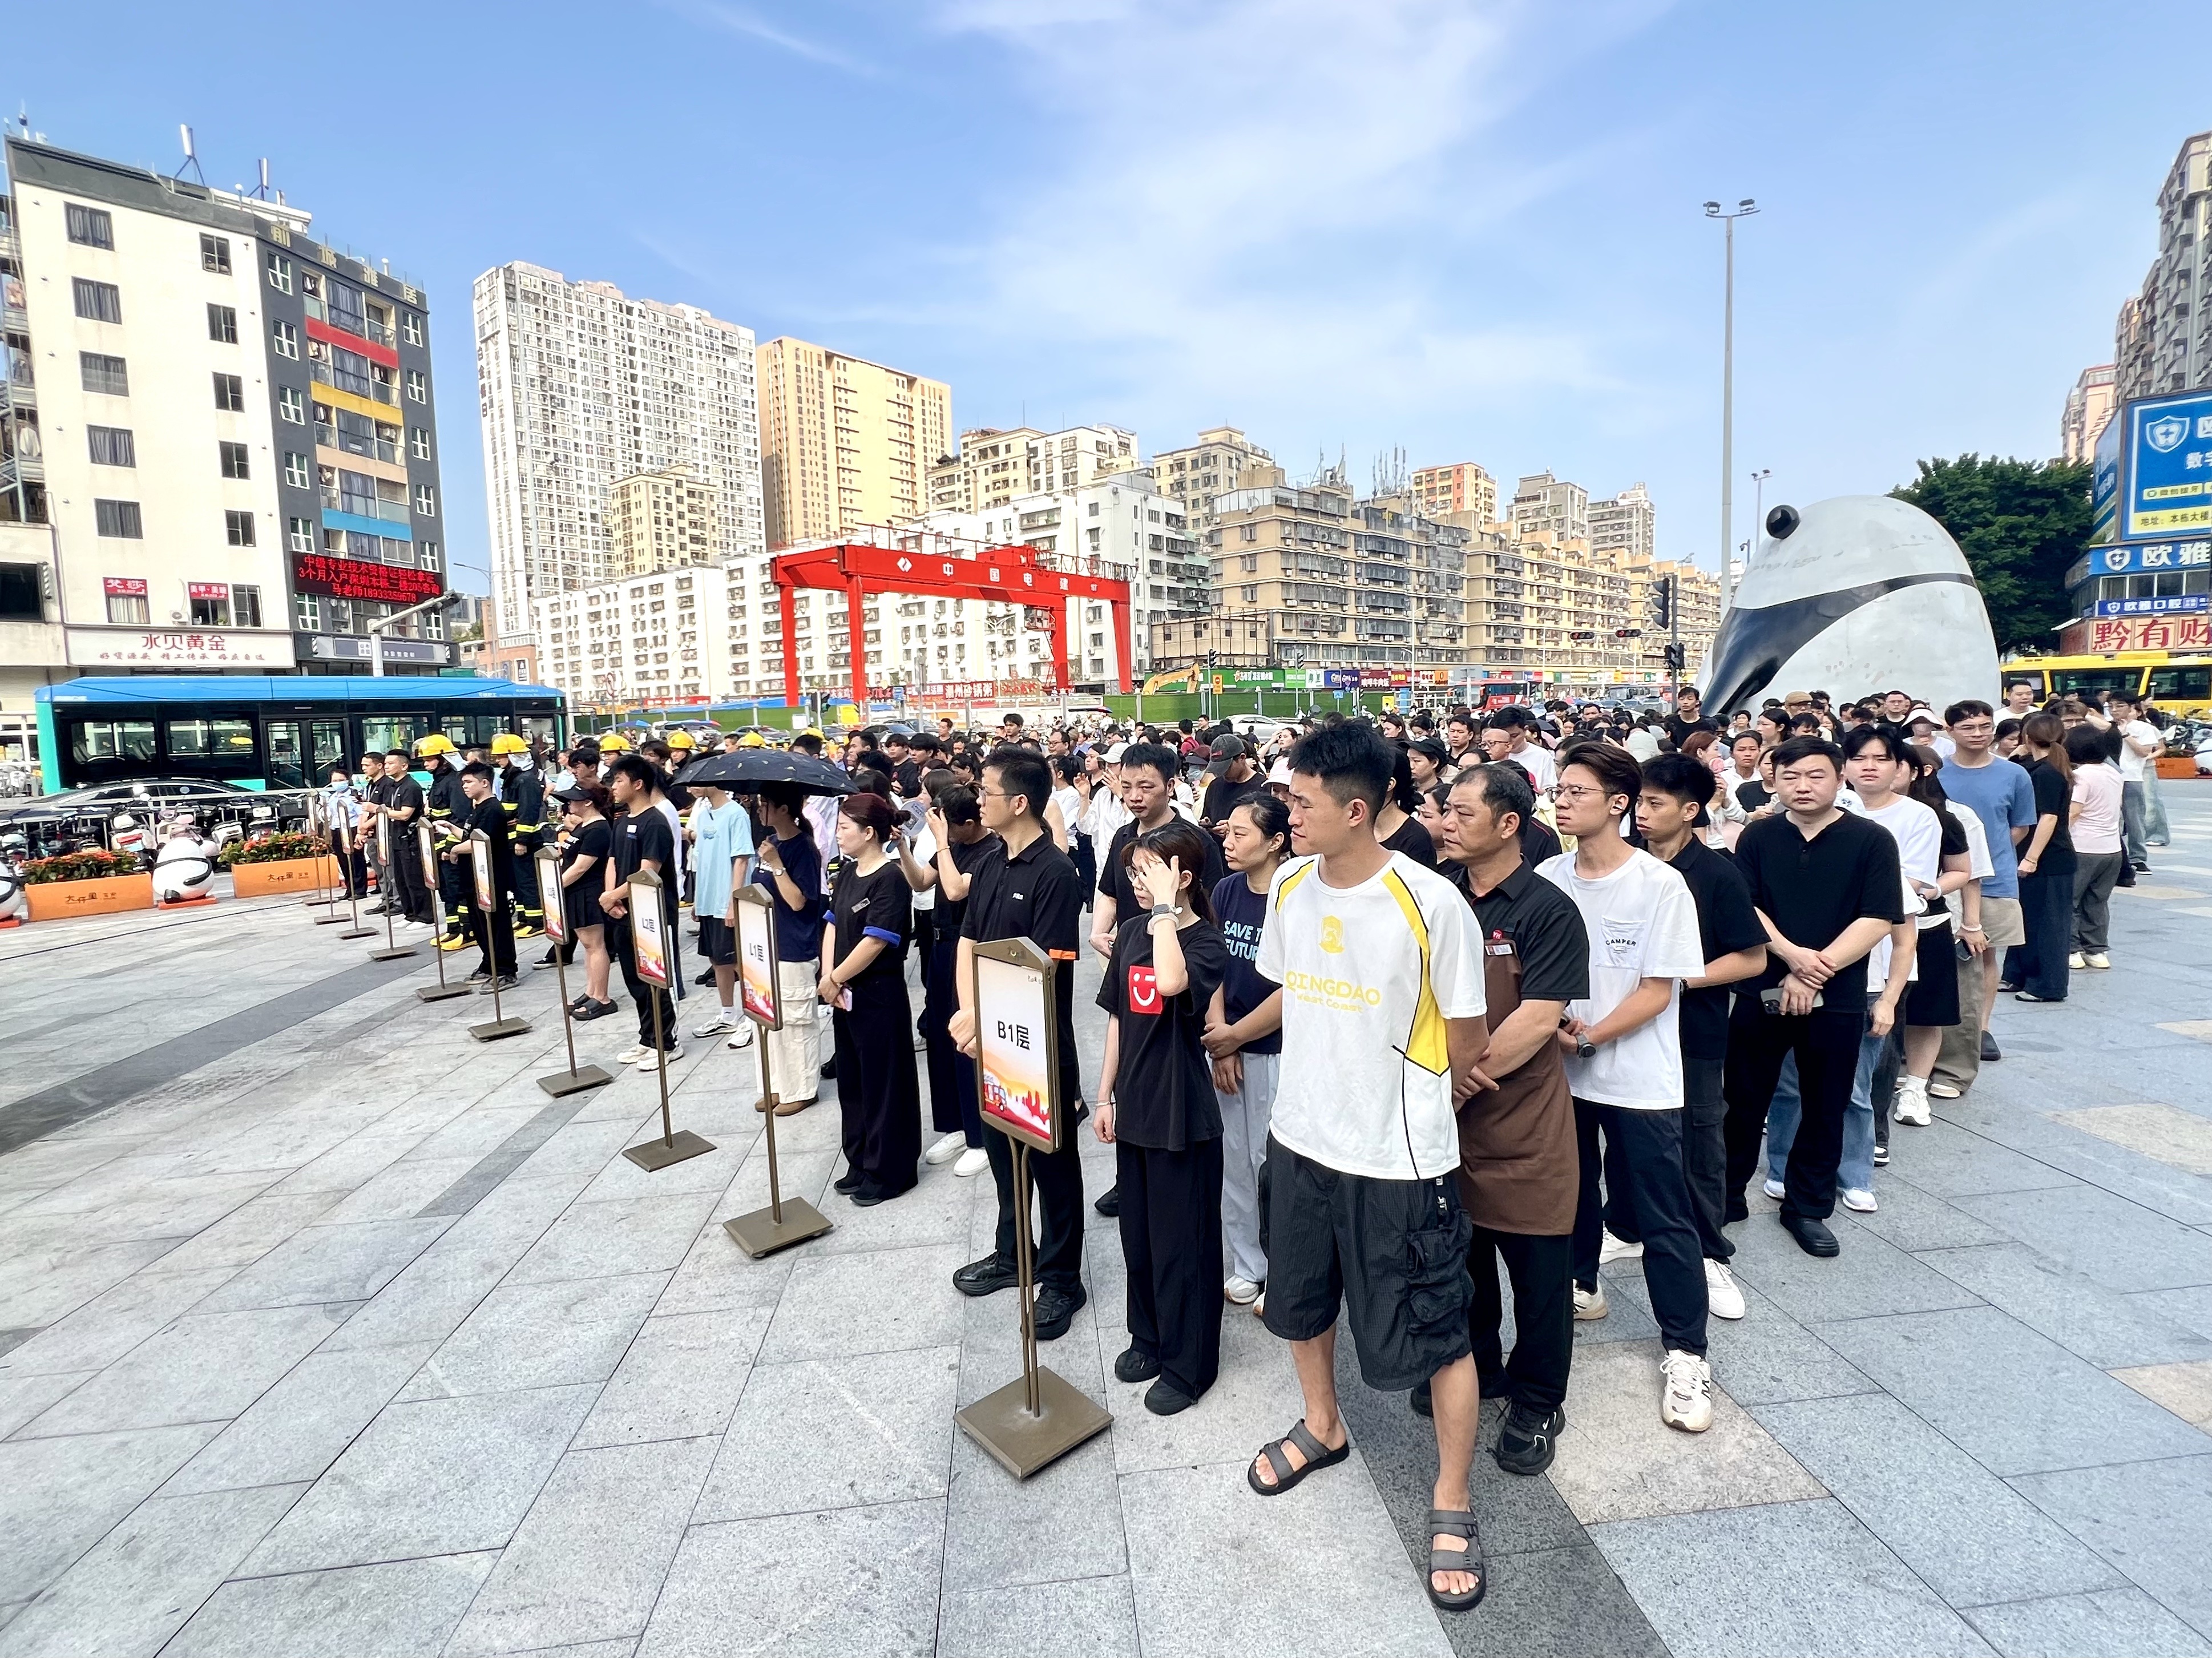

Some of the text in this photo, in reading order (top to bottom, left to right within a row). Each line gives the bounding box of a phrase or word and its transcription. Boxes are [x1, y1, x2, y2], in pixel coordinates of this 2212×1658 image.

[2142, 542, 2210, 567] 欧雅
[142, 634, 227, 651] 水贝黄金
[1224, 920, 1254, 941] SAVE
[1225, 939, 1259, 962] FUTUR
[1285, 970, 1381, 1006] QINGDAO
[998, 1020, 1031, 1051] B1层
